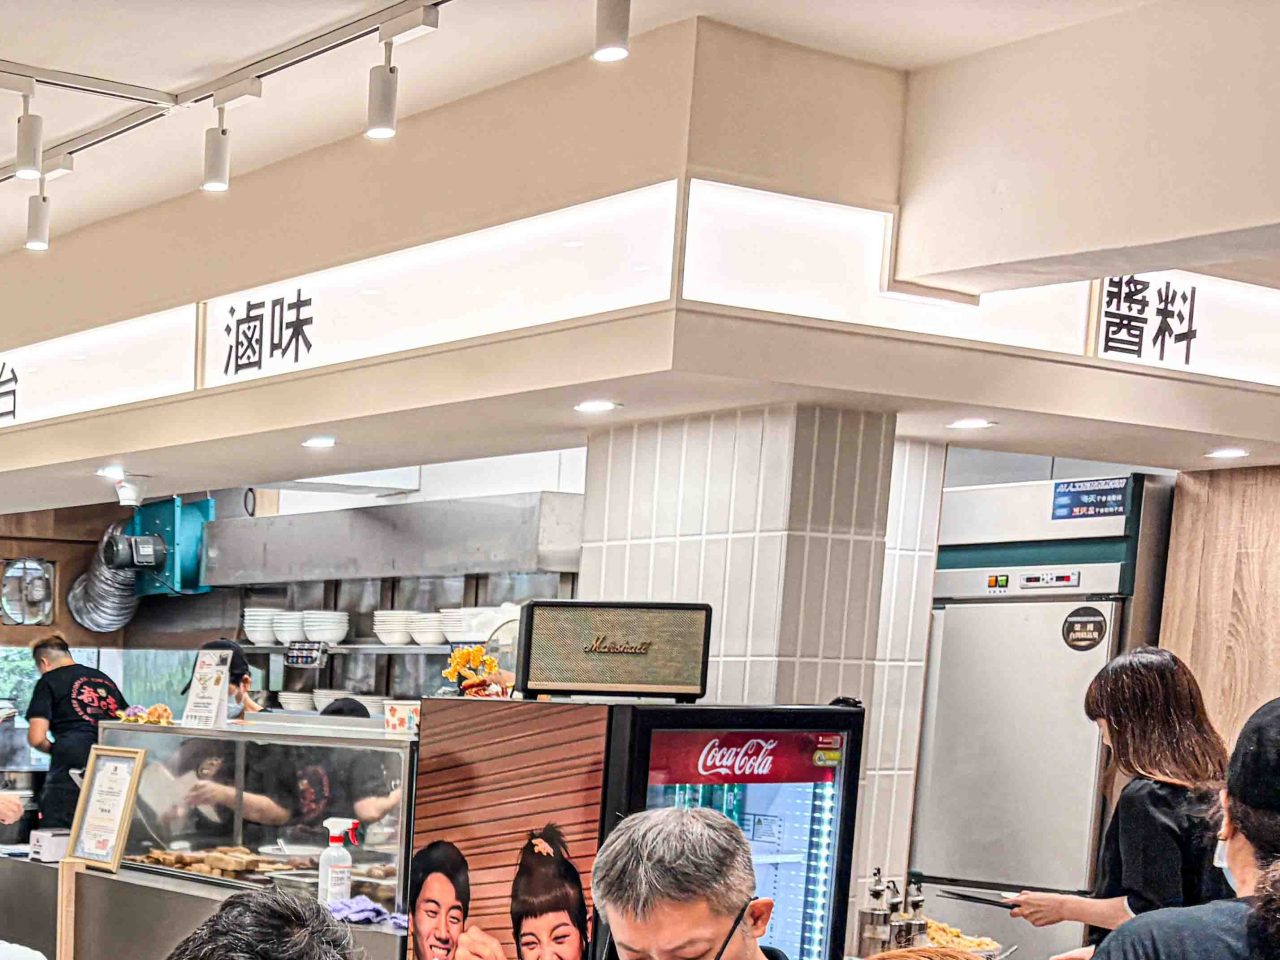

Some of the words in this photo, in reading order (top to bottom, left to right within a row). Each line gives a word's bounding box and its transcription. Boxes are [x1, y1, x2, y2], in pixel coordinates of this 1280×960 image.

[223, 288, 314, 376] 滷味
[1104, 274, 1197, 365] 醬料
[584, 635, 652, 655] Marshall
